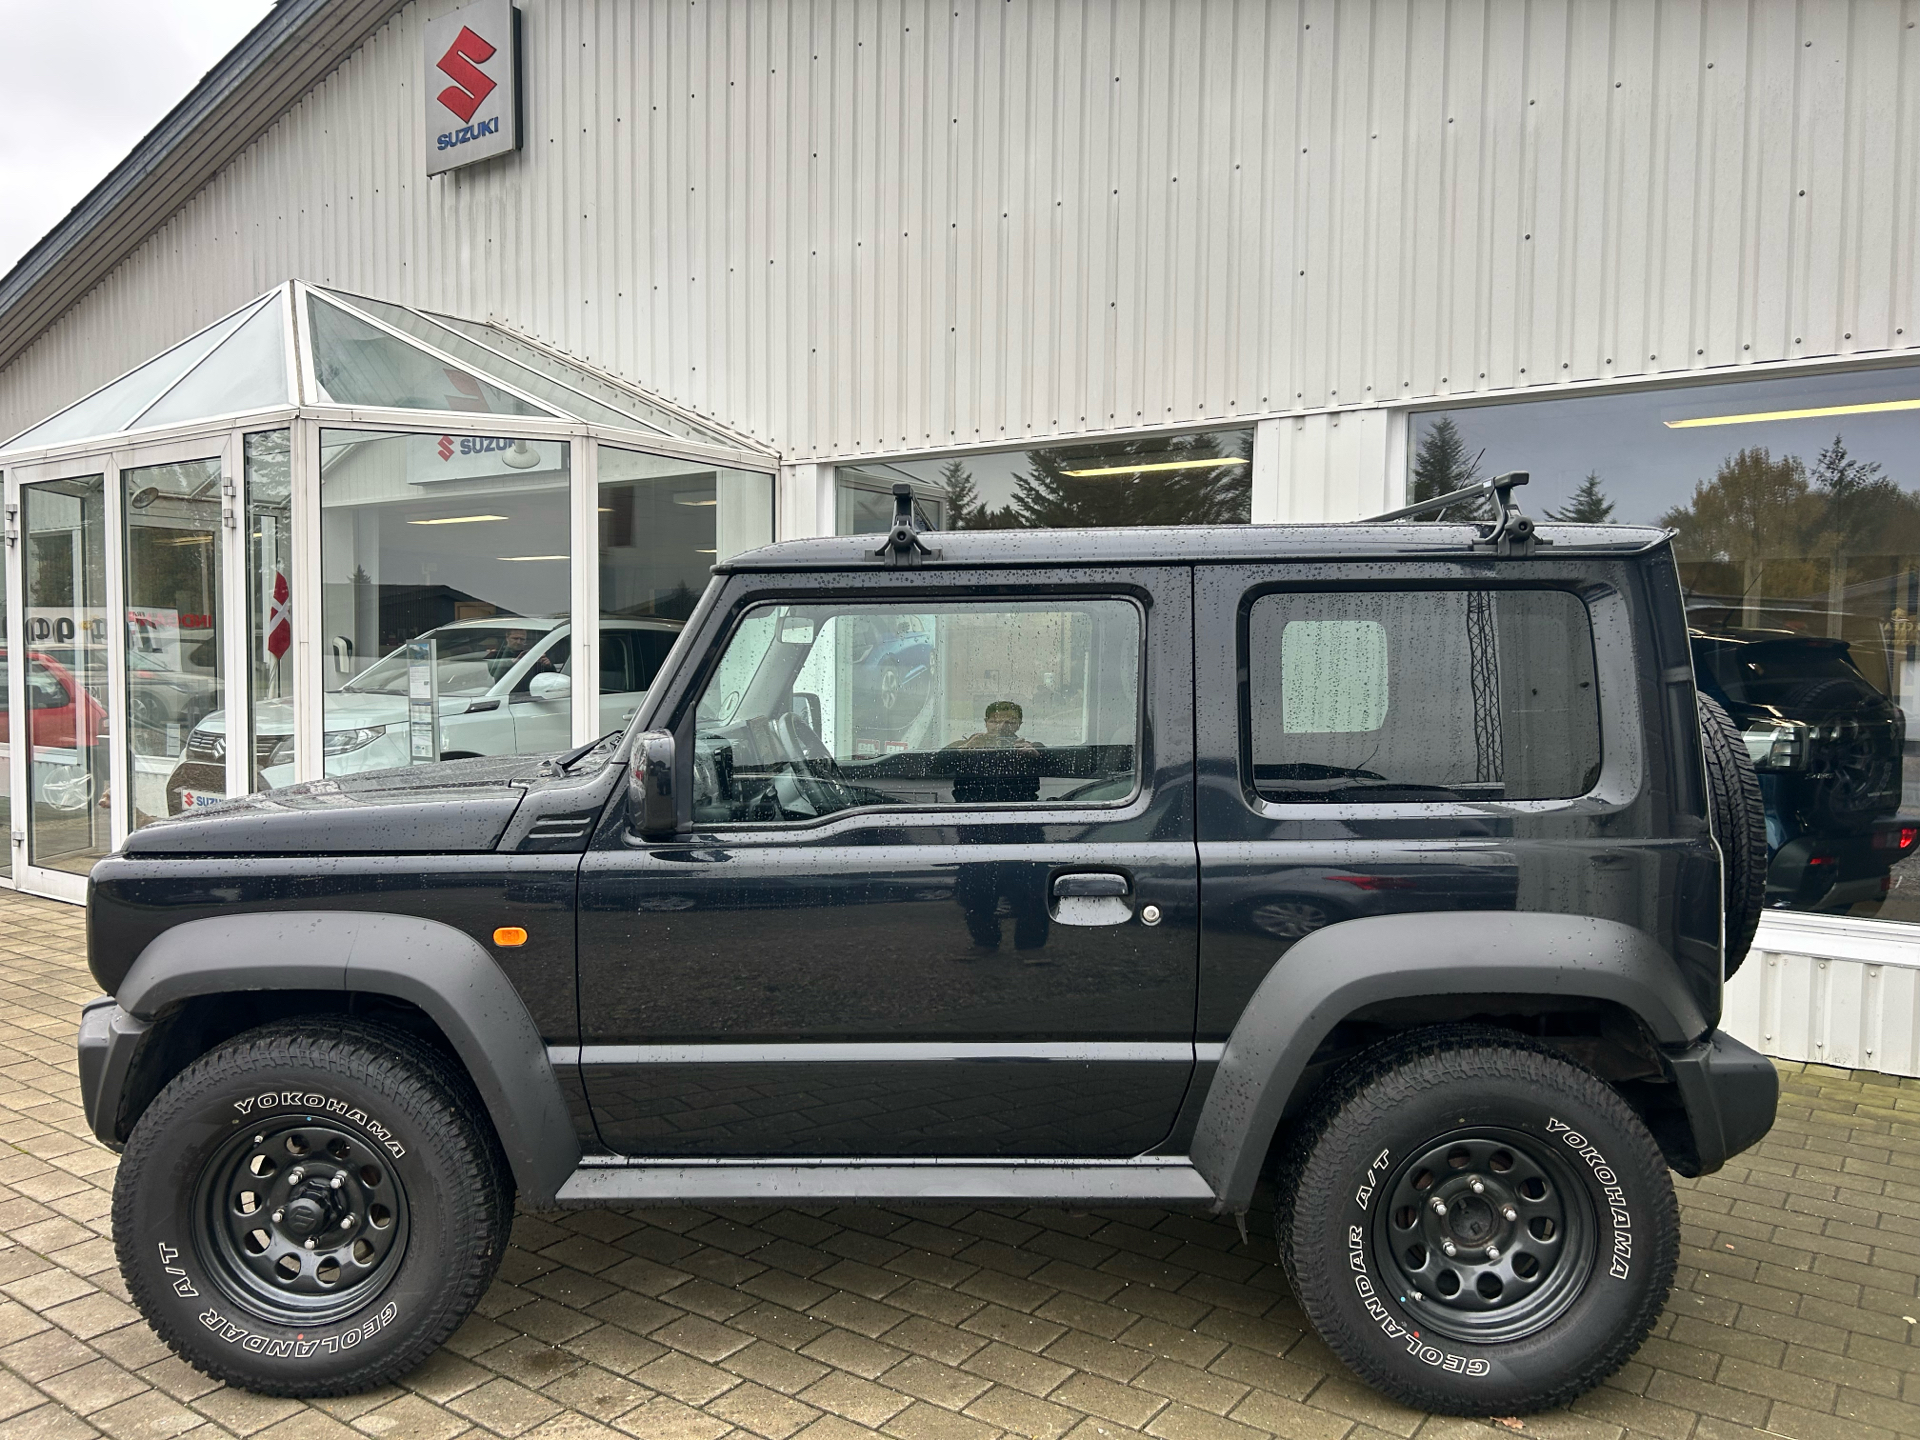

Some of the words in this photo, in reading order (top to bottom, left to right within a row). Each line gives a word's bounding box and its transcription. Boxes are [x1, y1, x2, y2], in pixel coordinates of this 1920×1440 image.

[437, 116, 499, 151] SUZUKI
[234, 1091, 406, 1159] YOKOHAMA
[1355, 1148, 1391, 1210] A/T
[1546, 1117, 1632, 1280] YOKOHAMA
[158, 1242, 199, 1298] A/T
[1348, 1225, 1490, 1377] GEOLANDAR
[198, 1301, 398, 1358] GEOLANDAR
